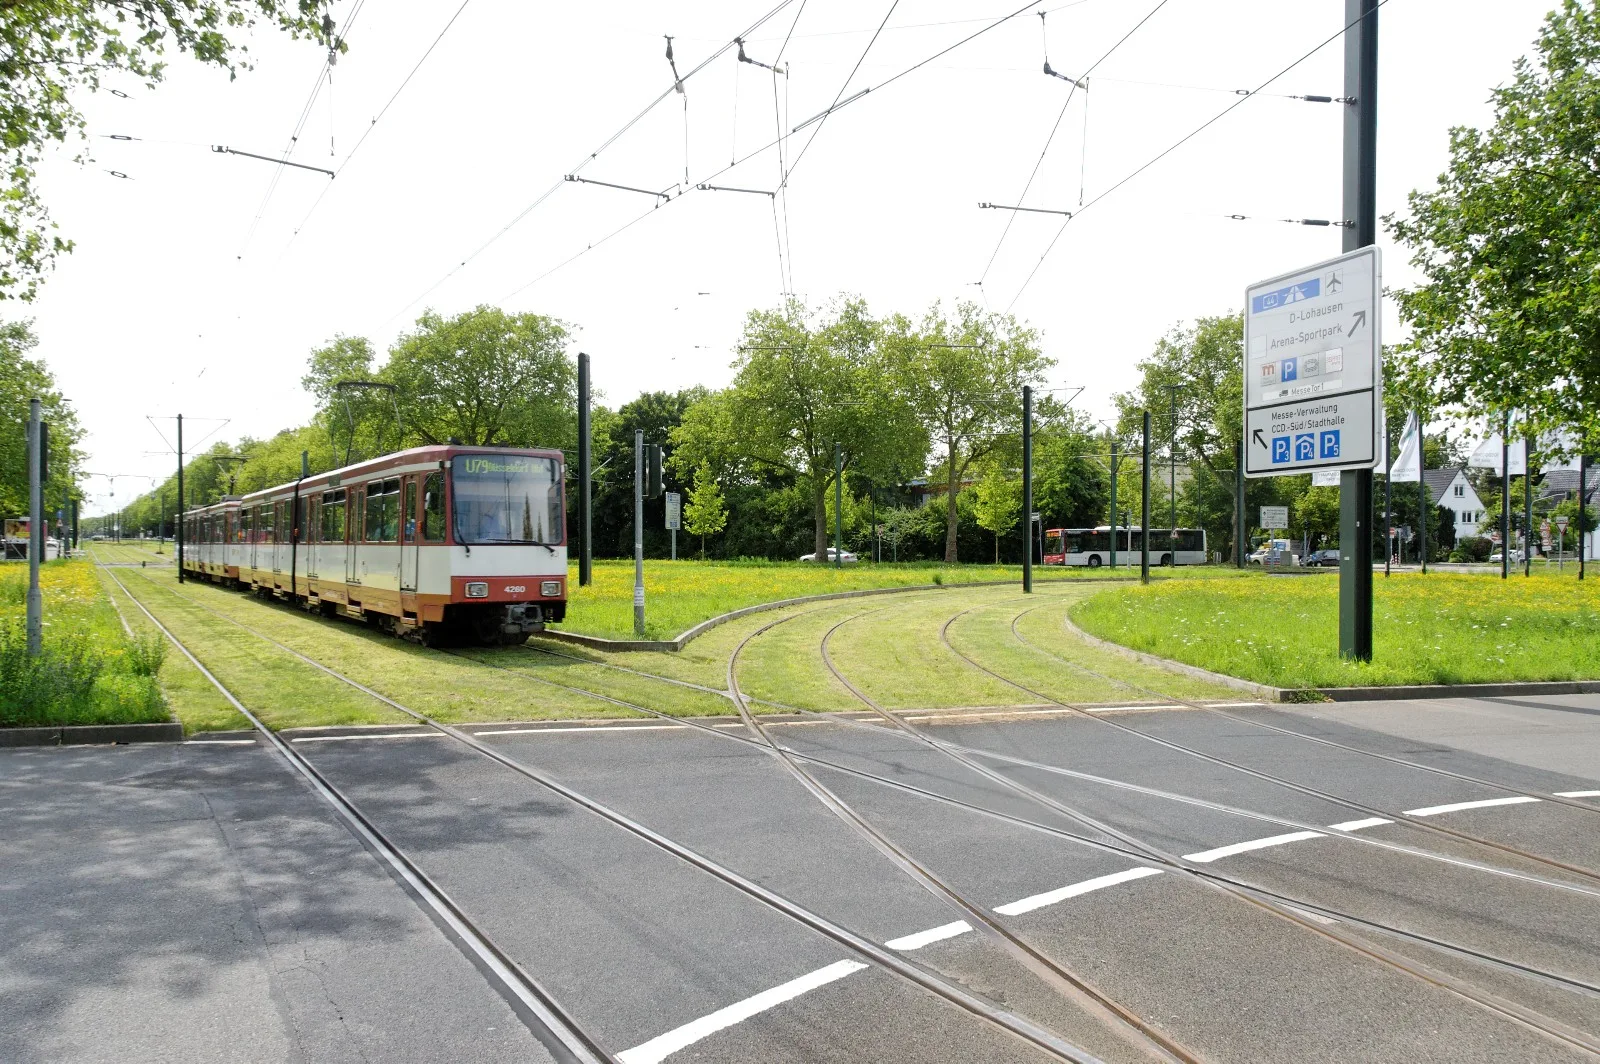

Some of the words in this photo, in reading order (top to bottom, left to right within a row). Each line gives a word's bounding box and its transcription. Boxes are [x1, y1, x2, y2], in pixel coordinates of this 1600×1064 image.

[1290, 302, 1343, 324] D-Lohausen
[1271, 324, 1343, 350] Arena-Sportpark
[1285, 362, 1294, 379] P
[1271, 404, 1338, 421] Messe-Verwaltung
[465, 459, 488, 474] U79
